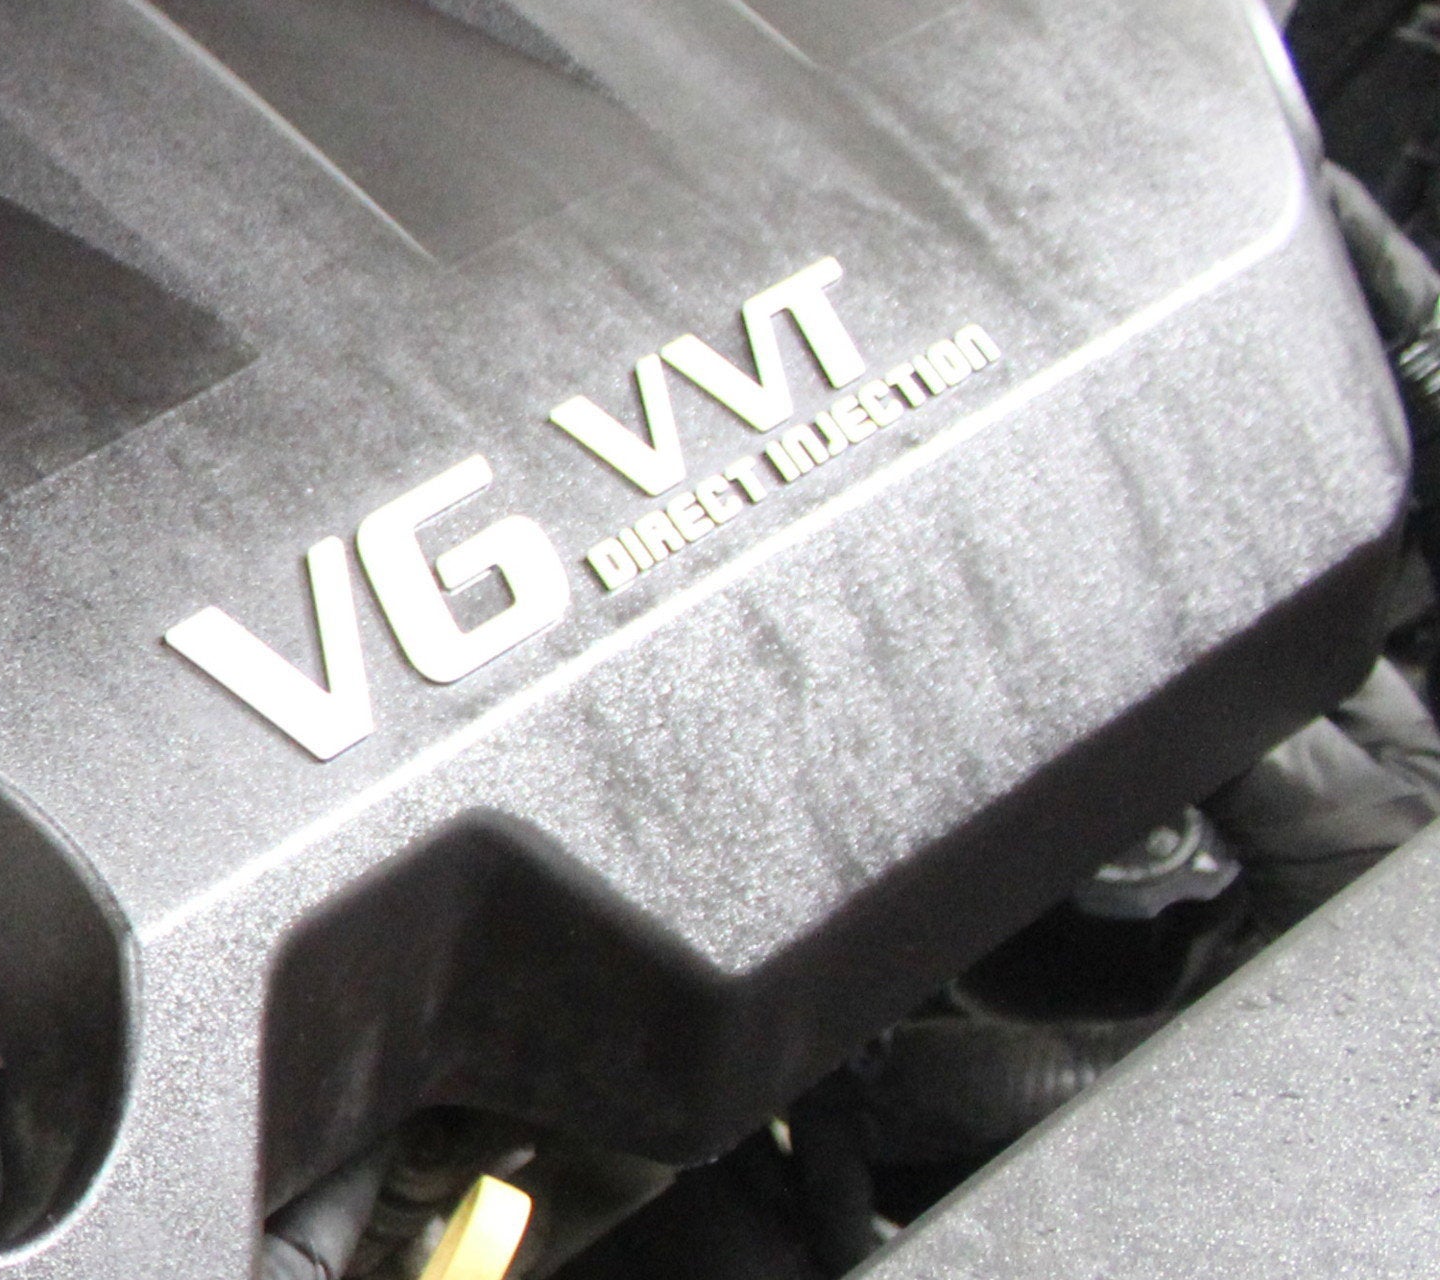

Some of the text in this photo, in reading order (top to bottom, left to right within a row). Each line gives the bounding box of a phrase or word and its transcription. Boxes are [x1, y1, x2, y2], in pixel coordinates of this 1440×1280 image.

[164, 256, 866, 761] V6 VVT
[587, 323, 1002, 592] DIRECT INJECTION
